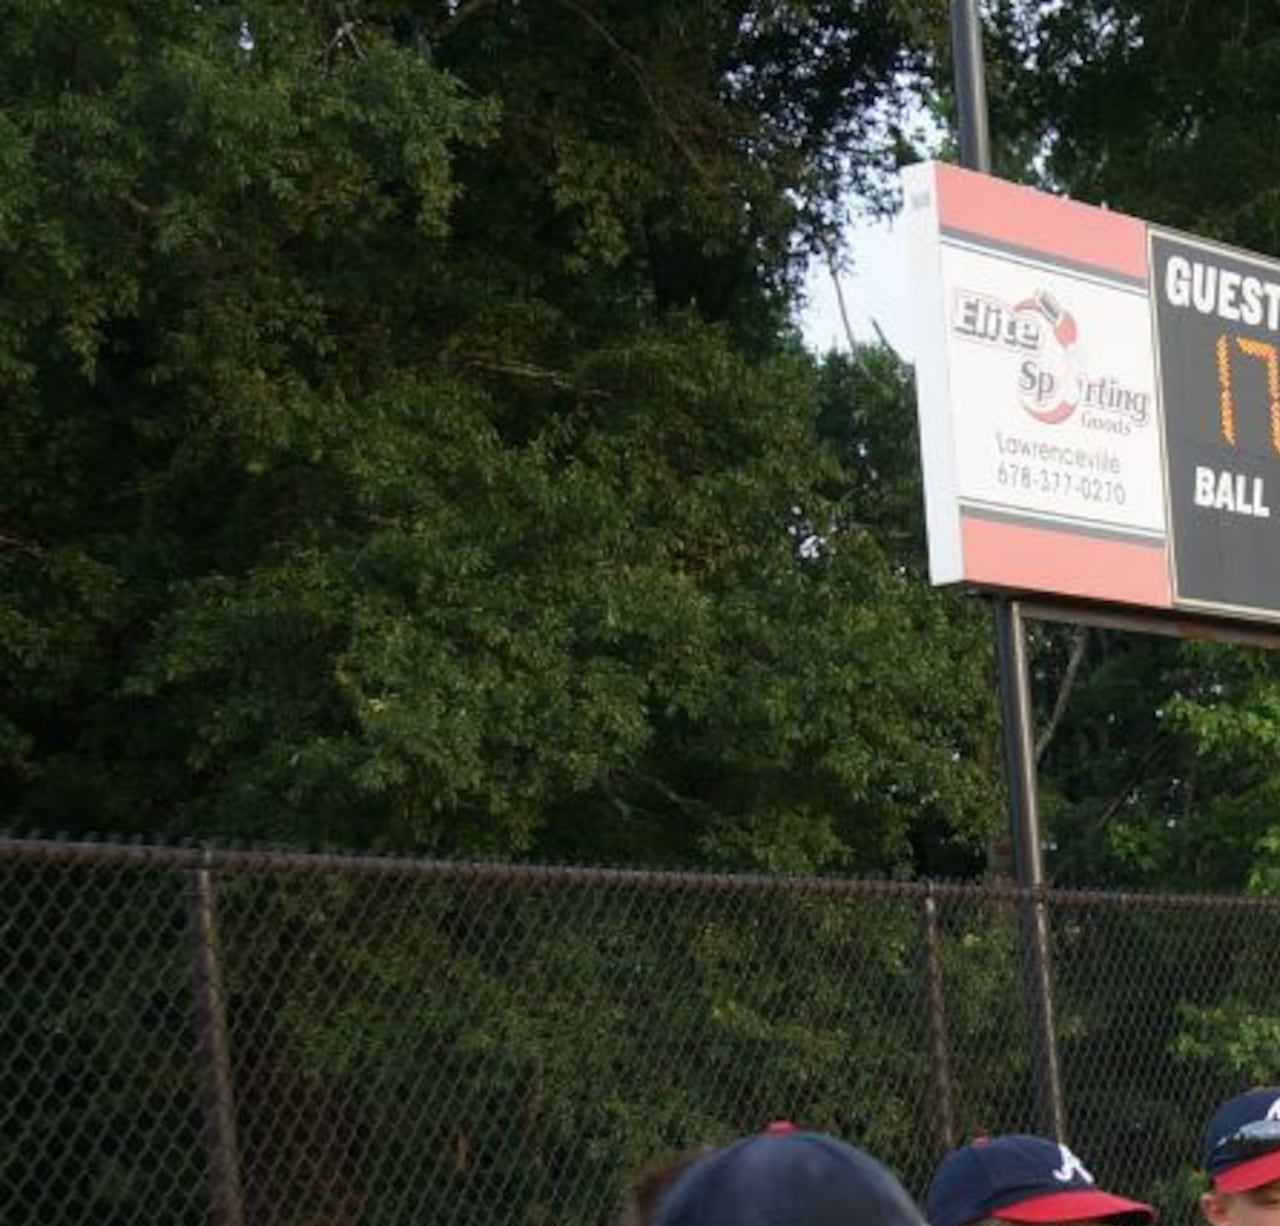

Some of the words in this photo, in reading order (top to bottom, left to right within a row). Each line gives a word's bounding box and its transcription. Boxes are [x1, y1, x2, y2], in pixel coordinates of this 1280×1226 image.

[956, 297, 1041, 351] Elite
[1080, 411, 1132, 436] Goods
[996, 430, 1121, 474] Lawrenceville
[1194, 466, 1270, 517] BALL
